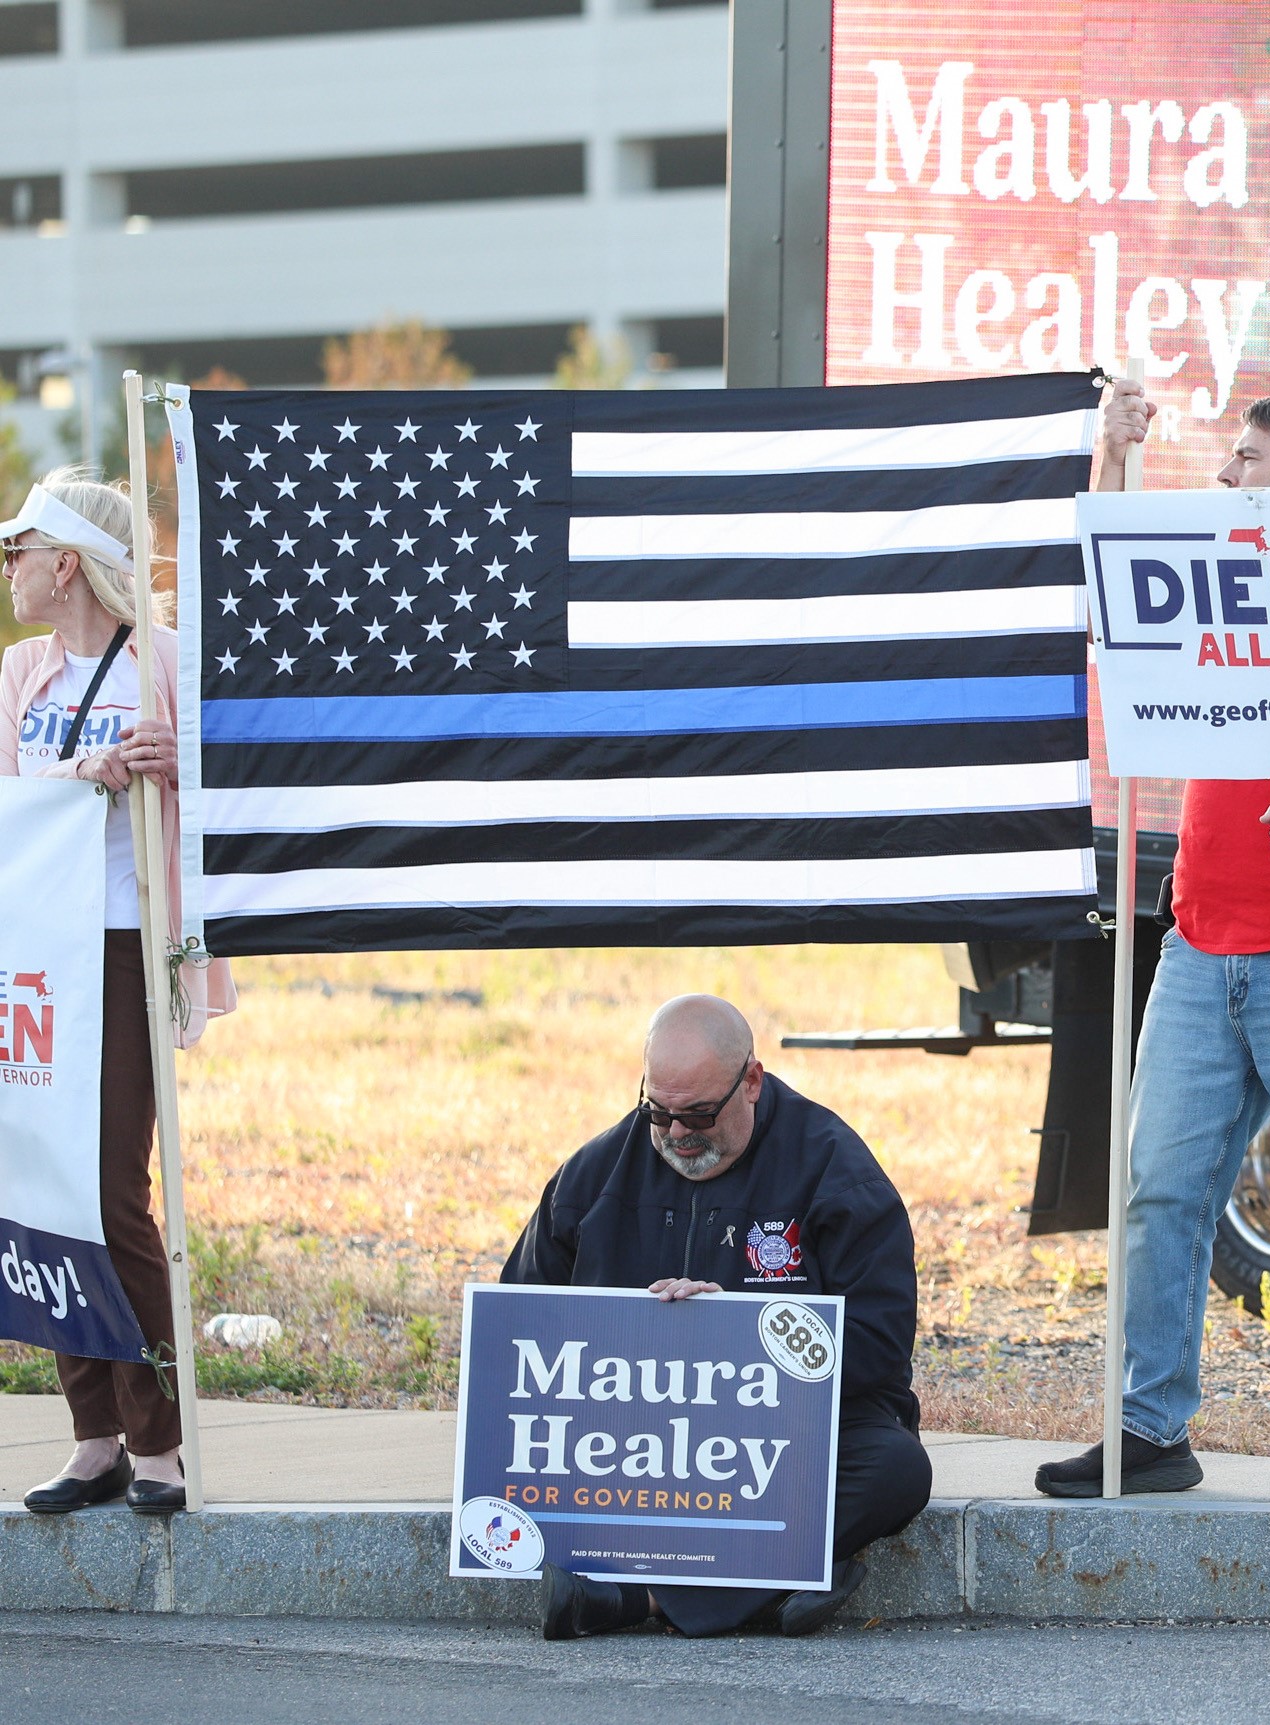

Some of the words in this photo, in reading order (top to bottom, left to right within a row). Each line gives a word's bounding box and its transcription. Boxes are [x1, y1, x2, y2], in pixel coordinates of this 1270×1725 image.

[865, 60, 1249, 209] Maura
[862, 231, 1267, 420] Healey
[0, 1068, 52, 1087] ERNOR
[763, 1221, 785, 1231] 589
[1, 1240, 87, 1320] day!
[769, 1308, 828, 1370] 589
[802, 1313, 824, 1338] LOCAL
[764, 1326, 780, 1344] BOSTON
[779, 1342, 799, 1362] CARMEN'S
[798, 1362, 811, 1376] UNION
[509, 1338, 781, 1408] Maura
[505, 1413, 791, 1500] Healey
[489, 1501, 527, 1525] ESTABLISHED
[526, 1523, 536, 1538] 1912
[505, 1485, 560, 1504] FOR
[573, 1487, 733, 1511] GOVERNOR
[466, 1533, 492, 1561] LOCAL
[494, 1558, 513, 1570] 589
[677, 1554, 716, 1562] COMMITTEE
